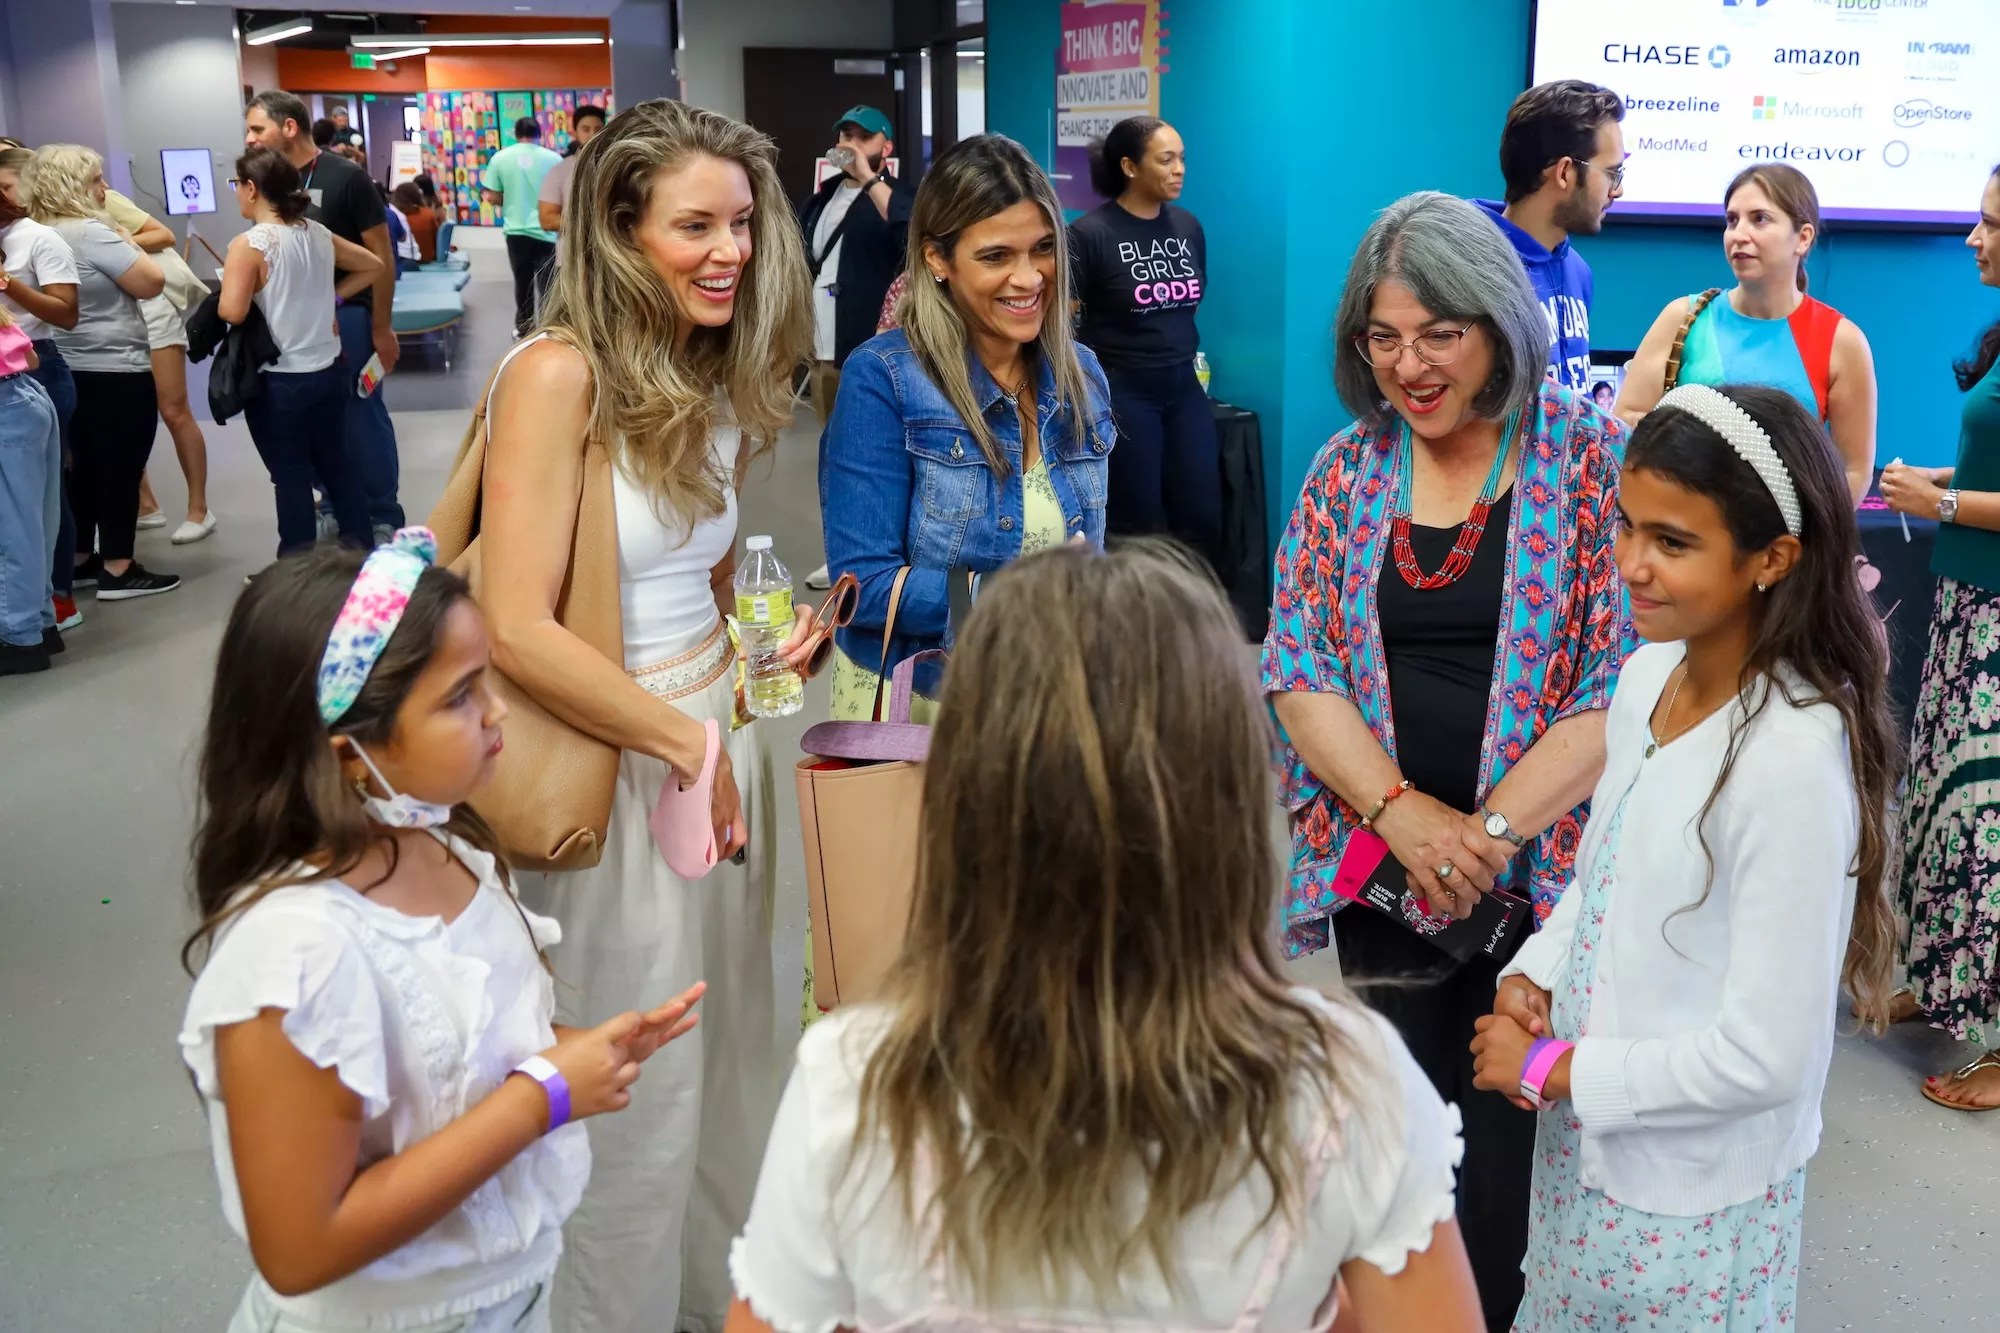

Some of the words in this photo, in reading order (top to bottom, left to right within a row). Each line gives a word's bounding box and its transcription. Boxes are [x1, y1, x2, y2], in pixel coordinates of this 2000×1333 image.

[1064, 23, 1109, 63] THINK
[1603, 43, 1700, 65] CHASE
[1774, 48, 1860, 66] amazon
[1059, 74, 1116, 103] INNOVATE
[1119, 71, 1148, 101] AND
[1625, 94, 1720, 112] breezeline
[1783, 101, 1864, 120] Microsoft
[1893, 104, 1972, 121] OpenStore
[1060, 118, 1092, 137] CHANGE
[1094, 118, 1110, 137] THE
[1638, 137, 1708, 151] ModMed
[1738, 142, 1866, 162] endeavor
[1118, 238, 1192, 263] BLACK
[1131, 258, 1195, 281] GIRLS
[1134, 279, 1200, 304] CODE
